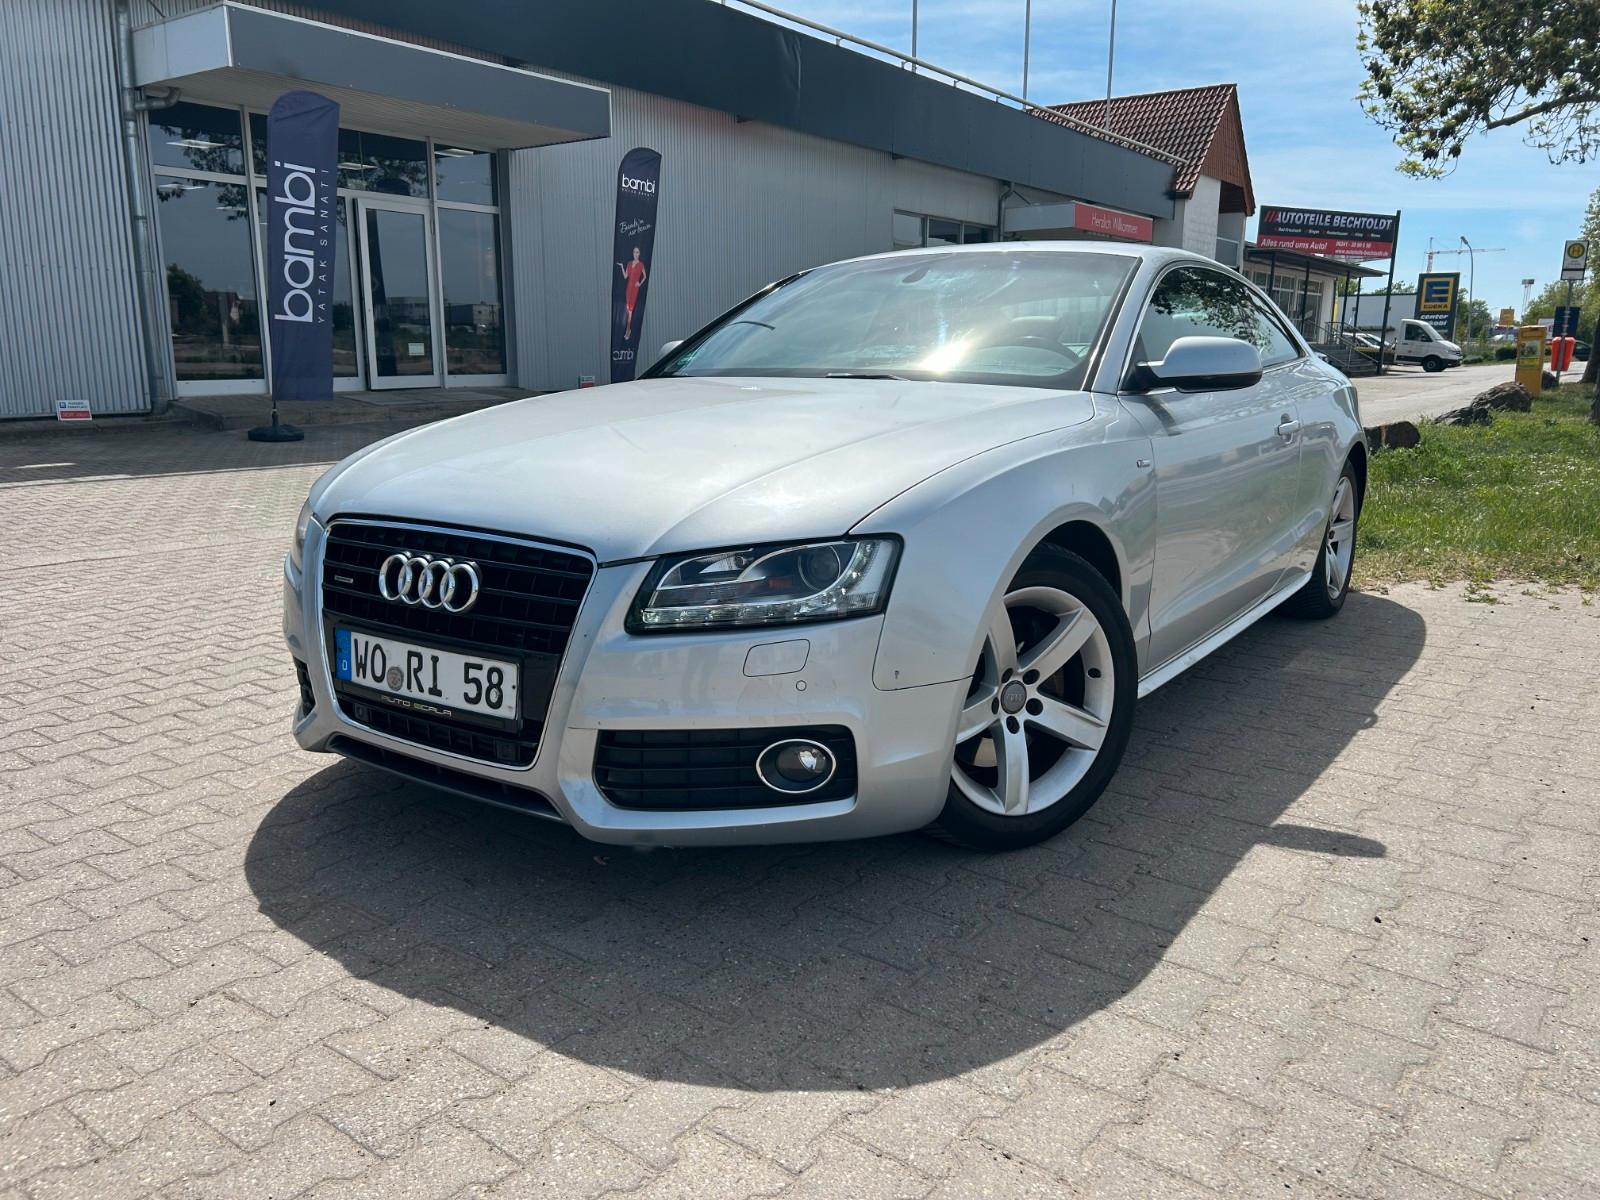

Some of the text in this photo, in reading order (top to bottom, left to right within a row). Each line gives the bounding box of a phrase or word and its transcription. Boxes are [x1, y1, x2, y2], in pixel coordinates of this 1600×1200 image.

[622, 174, 655, 193] bambi
[1275, 211, 1392, 230] AUTOTEILE BECHTOLDT
[274, 161, 315, 322] bambi
[318, 169, 329, 323] YATAK SANATI
[1261, 239, 1278, 248] Alles
[1279, 240, 1295, 248] rund
[1310, 241, 1328, 250] Auto!
[342, 660, 348, 671] D
[354, 638, 504, 709] WO RI 58
